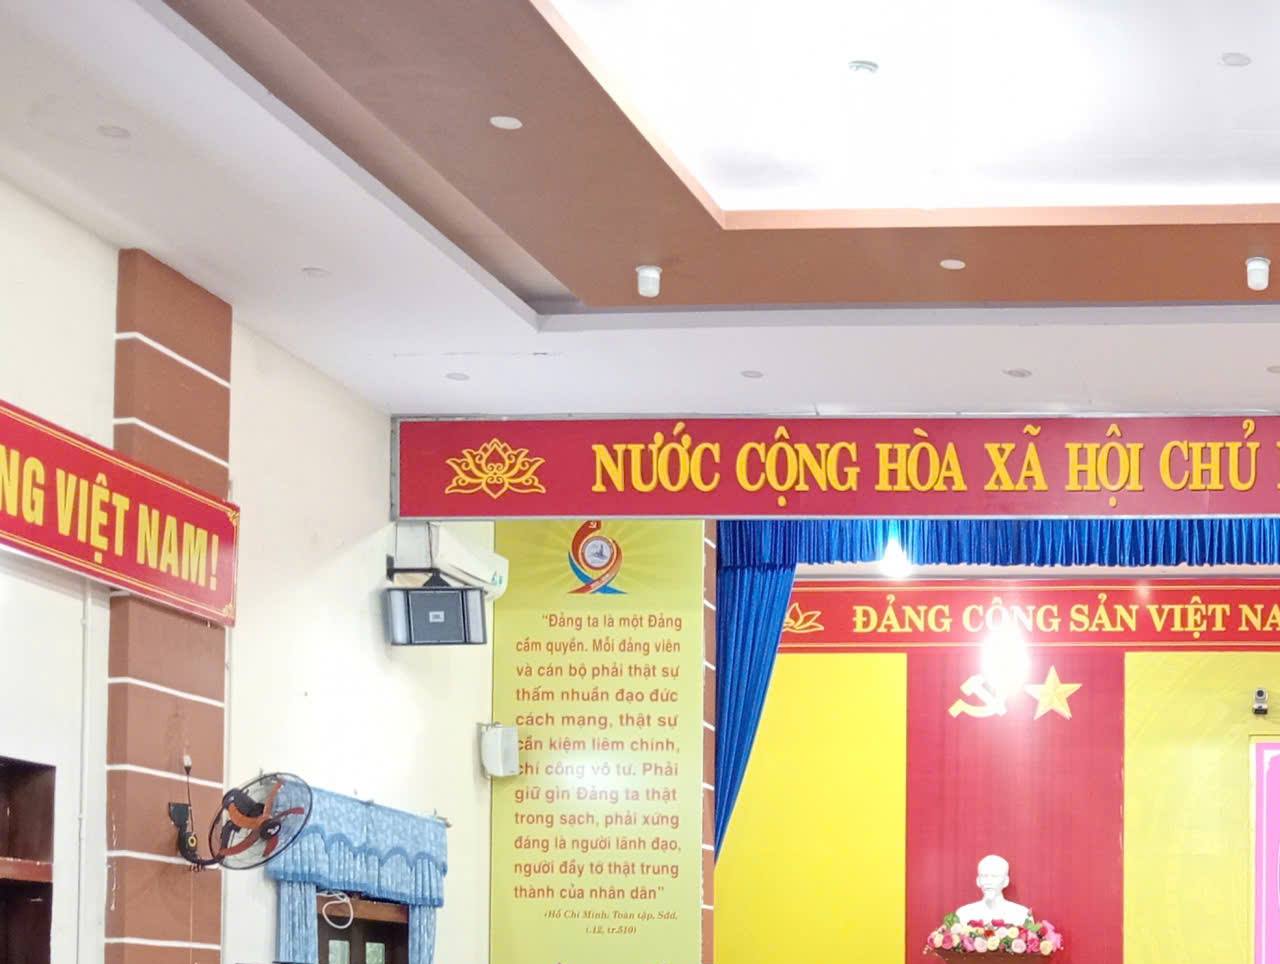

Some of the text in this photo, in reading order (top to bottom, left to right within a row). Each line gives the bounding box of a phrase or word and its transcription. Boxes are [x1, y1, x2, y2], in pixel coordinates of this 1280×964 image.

[591, 421, 721, 493] NƯỚC
[735, 425, 861, 507] CỘNG
[875, 427, 967, 492] HÒA
[984, 424, 1048, 492] XÃ
[1064, 423, 1145, 508] HỘI
[1159, 418, 1261, 491] CHỦ
[55, 468, 130, 564] VIỆT
[587, 615, 599, 628] ta
[603, 614, 615, 628] là
[618, 614, 644, 629] một
[647, 614, 683, 632] Đảng
[853, 595, 953, 634] ĐẢNG
[1070, 593, 1139, 632] SẢN
[1146, 595, 1231, 639] VIỆT
[515, 636, 542, 652] cầm
[591, 636, 615, 653] Mỗi
[618, 637, 650, 657] đảng
[654, 639, 681, 653] viên
[516, 662, 681, 680] và cán bộ phải thật sự
[614, 688, 645, 704] đạo
[649, 688, 679, 703] đức
[515, 712, 555, 727] cách
[619, 712, 651, 730] thật
[657, 715, 679, 729] sự
[591, 737, 625, 752] liêm
[641, 761, 679, 777] Phải
[514, 785, 677, 805] giữ gìn Đảng ta thật
[514, 812, 554, 829] trong
[604, 810, 637, 829] phải
[513, 835, 550, 853] đáng
[554, 837, 567, 850] là
[571, 836, 611, 854] người
[616, 836, 646, 850] lãnh
[513, 862, 555, 878] người
[589, 862, 604, 875] tớ
[607, 861, 636, 877] thật
[640, 862, 680, 879] trung
[513, 885, 554, 899] thành
[559, 883, 585, 900] của
[589, 886, 625, 900] nhân
